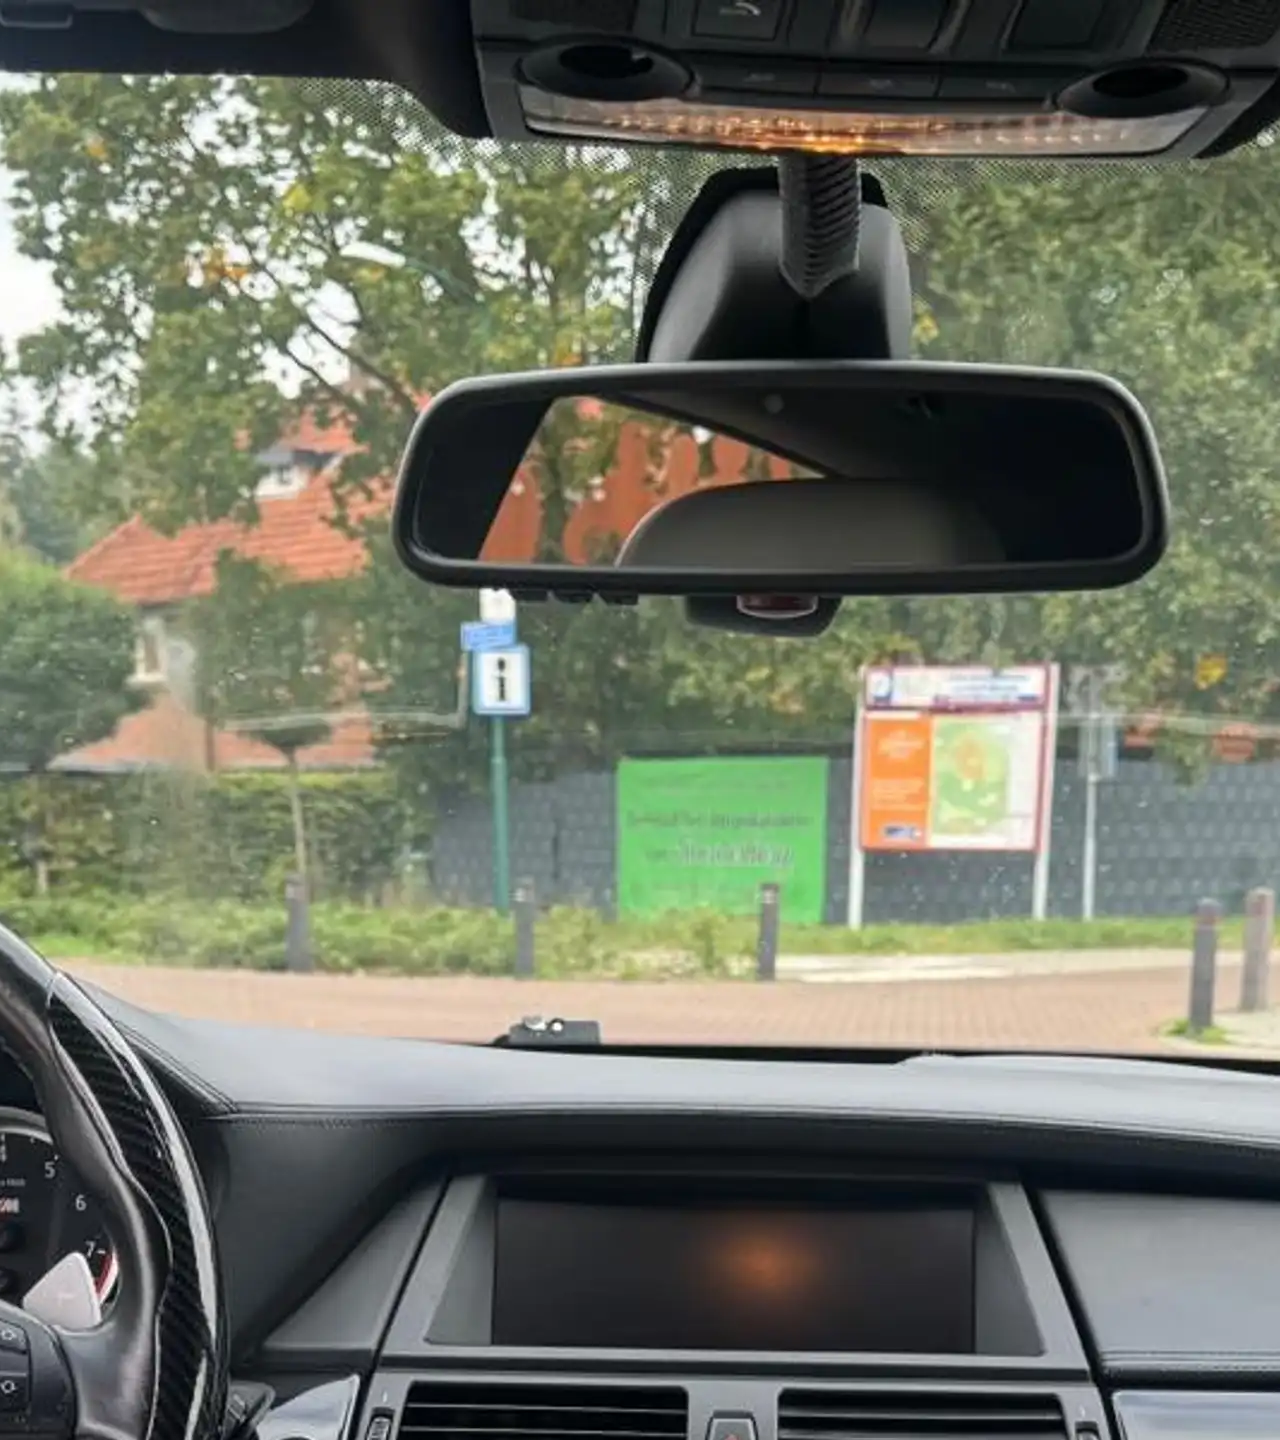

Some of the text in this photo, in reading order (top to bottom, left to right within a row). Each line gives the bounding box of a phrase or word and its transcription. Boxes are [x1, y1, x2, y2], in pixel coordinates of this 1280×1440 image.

[44, 1162, 56, 1178] 5
[75, 1195, 87, 1211] 6
[85, 1241, 96, 1257] 7
